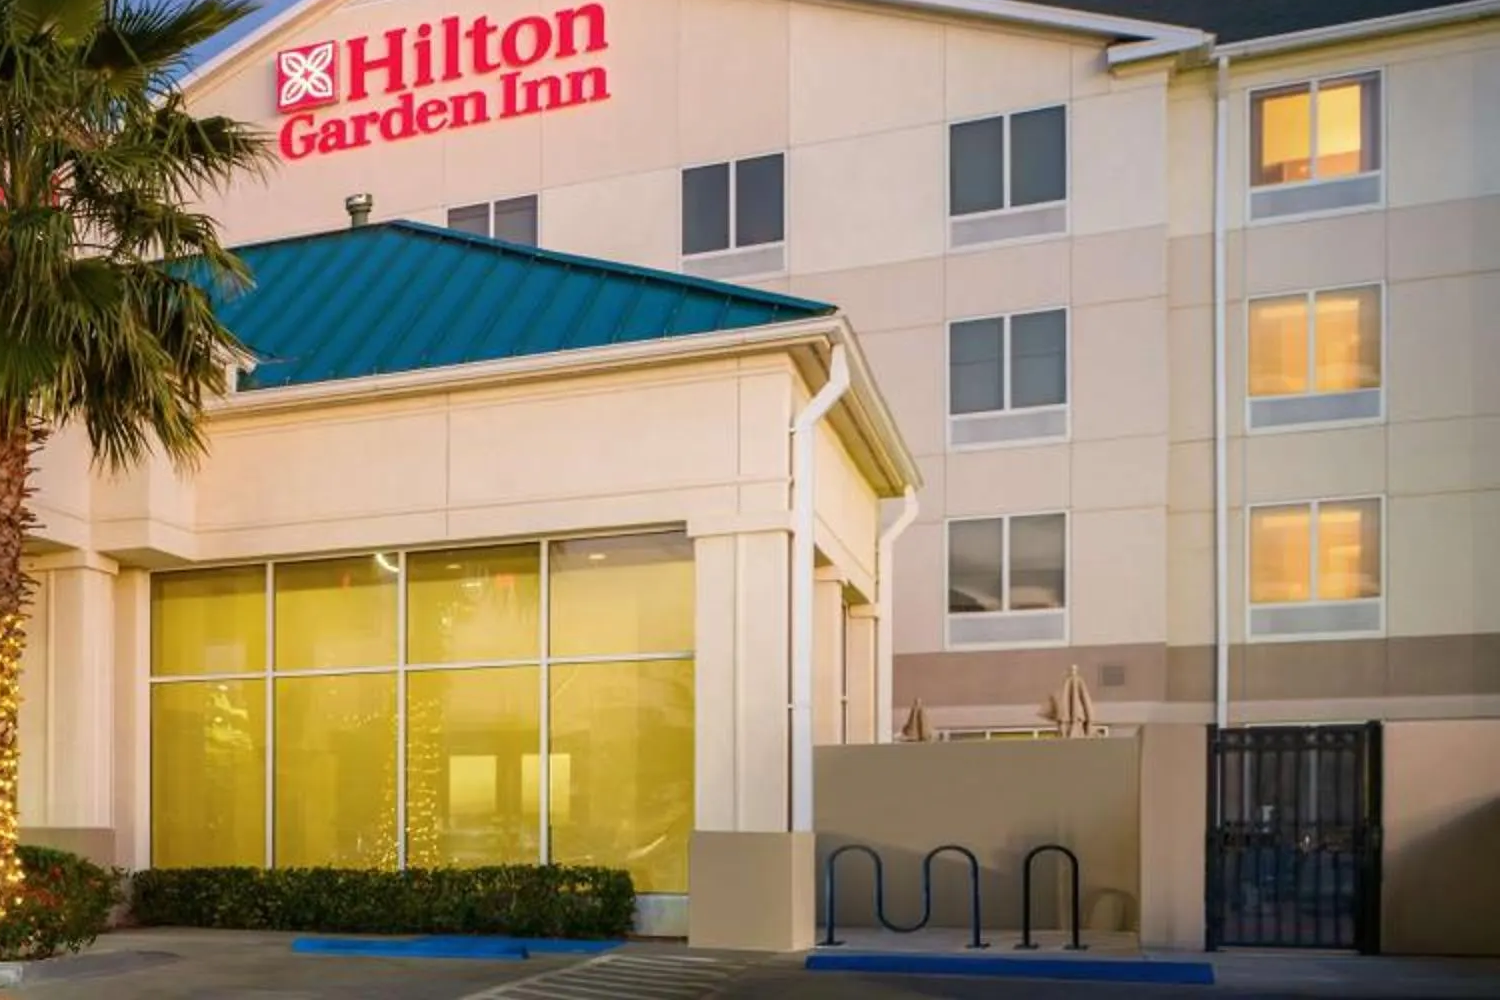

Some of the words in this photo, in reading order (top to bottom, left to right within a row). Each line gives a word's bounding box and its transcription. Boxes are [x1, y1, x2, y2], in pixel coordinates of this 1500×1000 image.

[345, 2, 610, 102] Hilton
[278, 89, 491, 161] Garden
[499, 65, 612, 120] Inn
